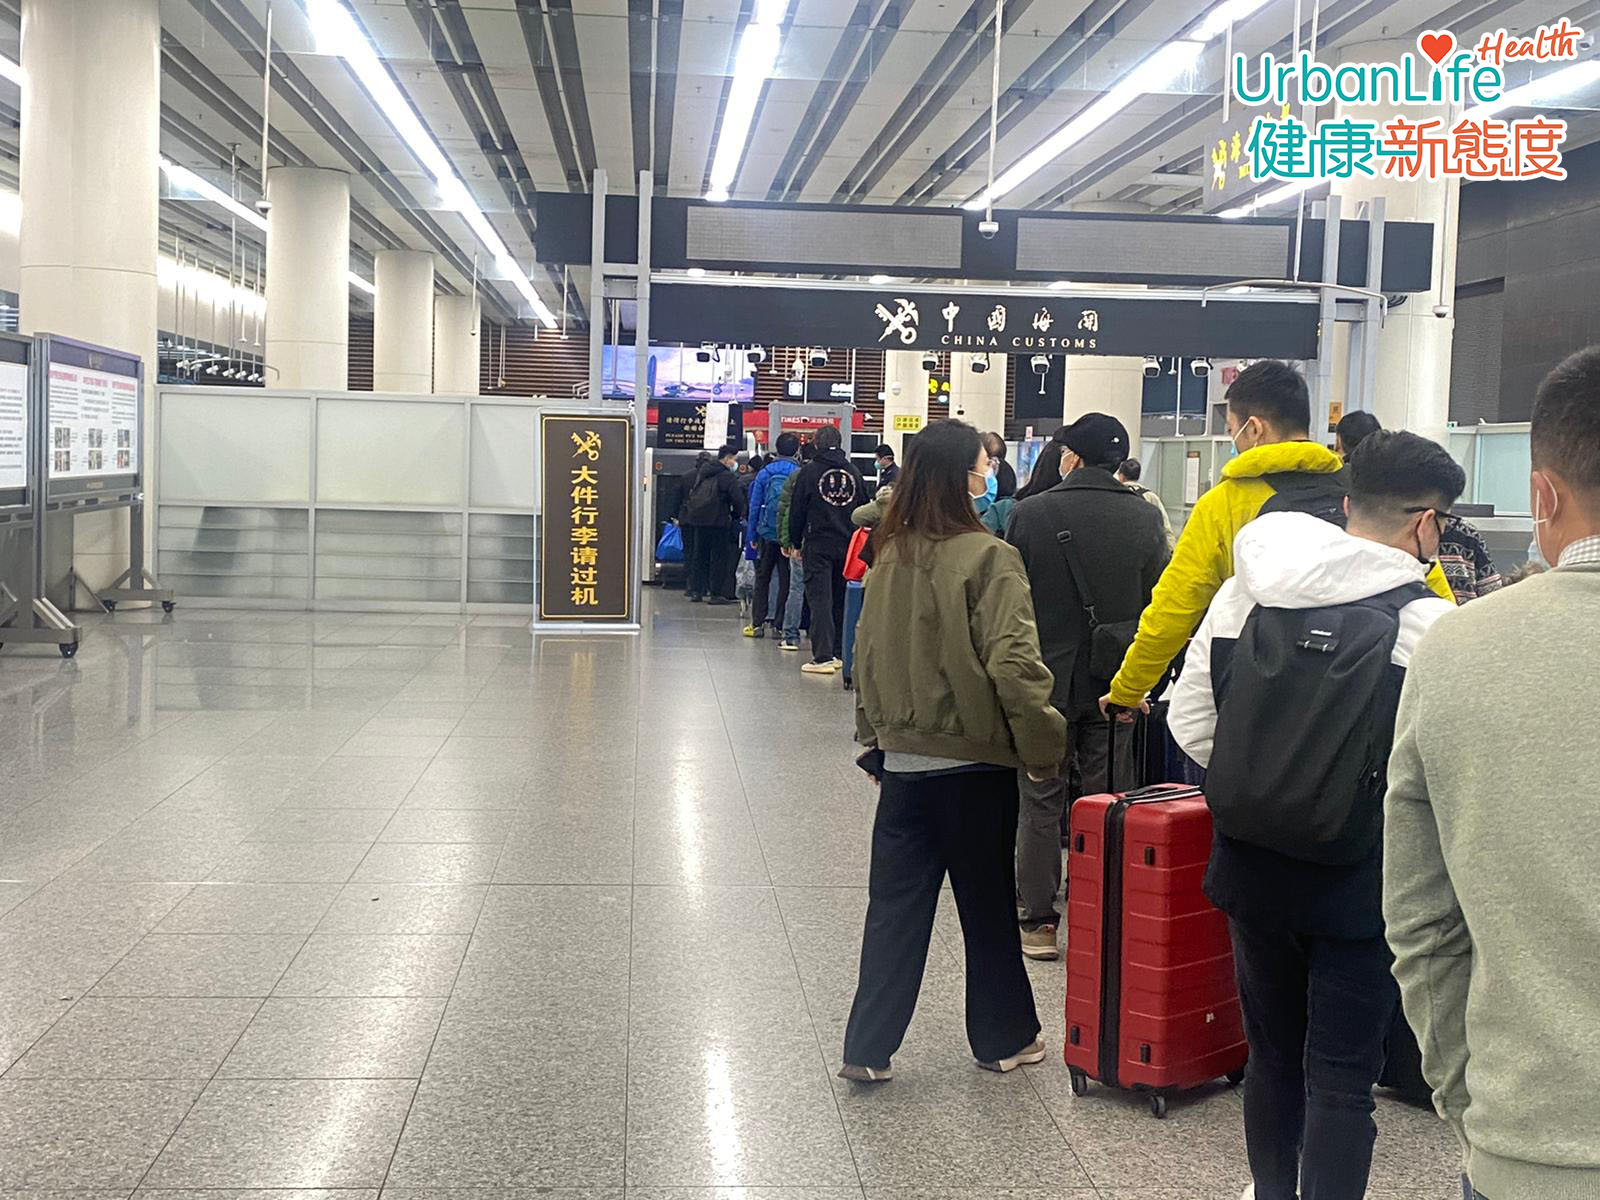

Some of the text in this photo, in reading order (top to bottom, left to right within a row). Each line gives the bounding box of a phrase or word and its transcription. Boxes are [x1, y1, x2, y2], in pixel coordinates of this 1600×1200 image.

[940, 334, 1097, 349] CHINA CUSTOMS
[570, 465, 599, 606] 大件行李请过机
